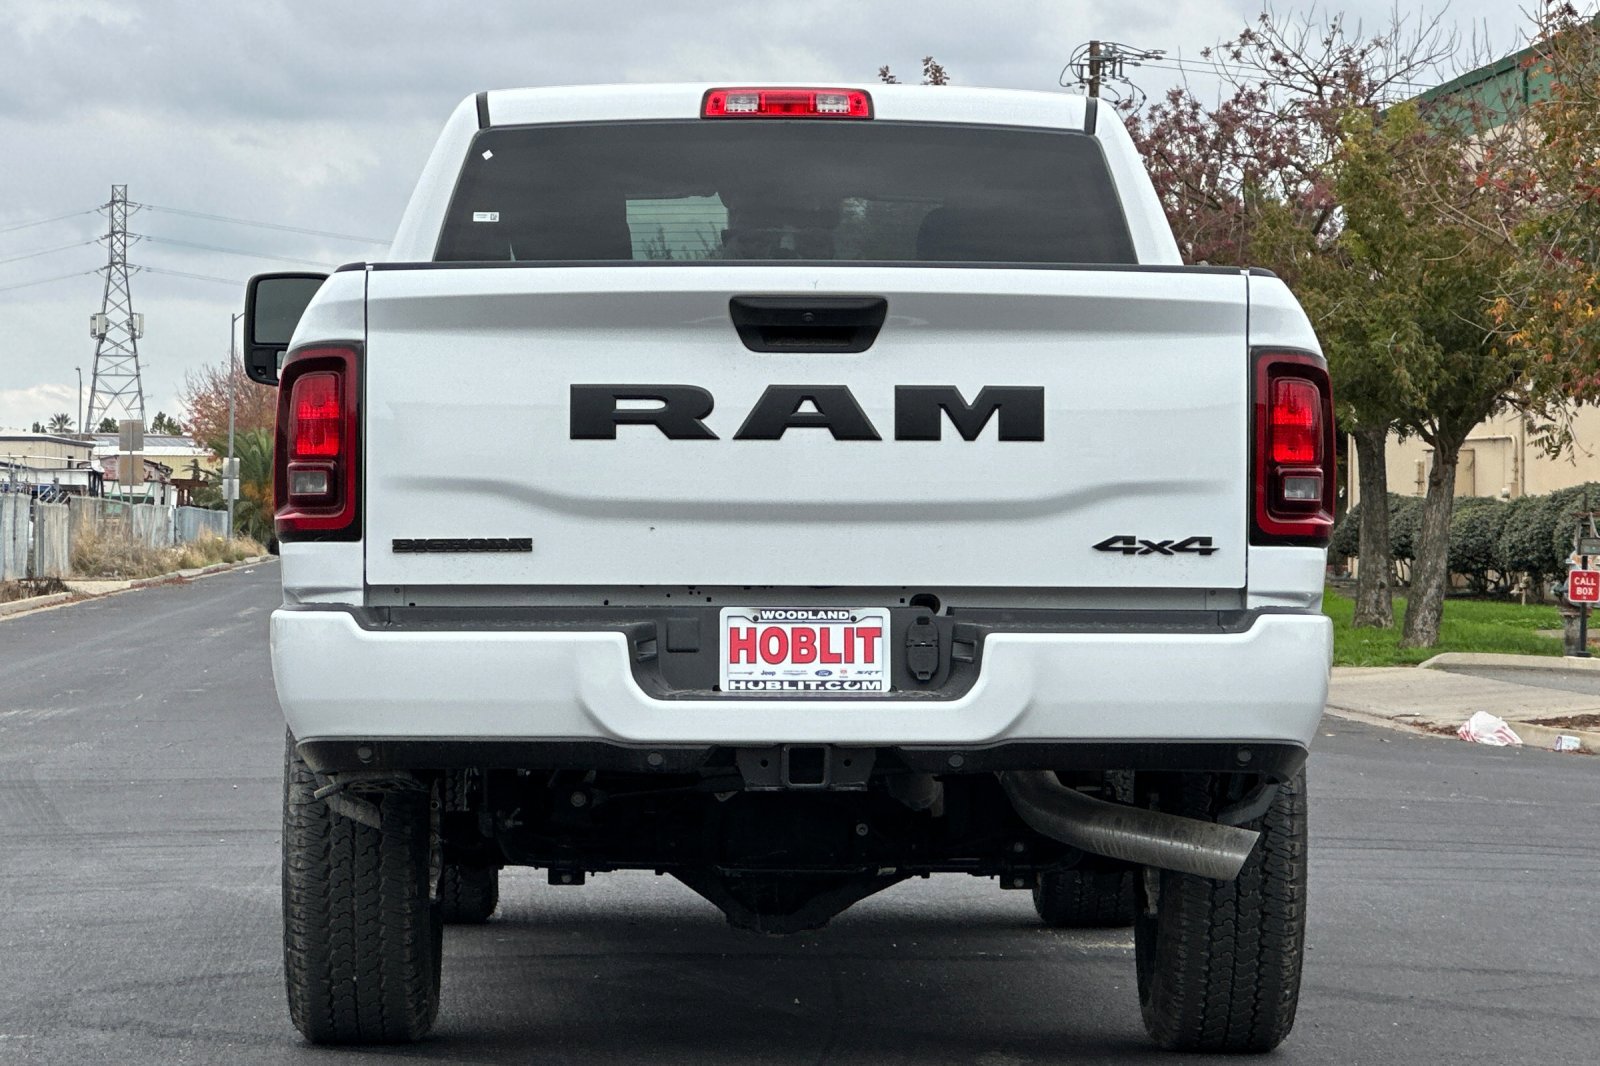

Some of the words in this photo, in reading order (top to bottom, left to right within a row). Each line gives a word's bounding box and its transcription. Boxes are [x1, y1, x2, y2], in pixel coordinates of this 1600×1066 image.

[570, 384, 1045, 441] RAM
[1091, 535, 1220, 556] 4x4
[1574, 576, 1597, 586] CALL
[1576, 587, 1594, 596] BOX
[761, 610, 849, 620] WOODLAND
[729, 626, 883, 665] HOBLIT
[760, 669, 777, 677] Jeep
